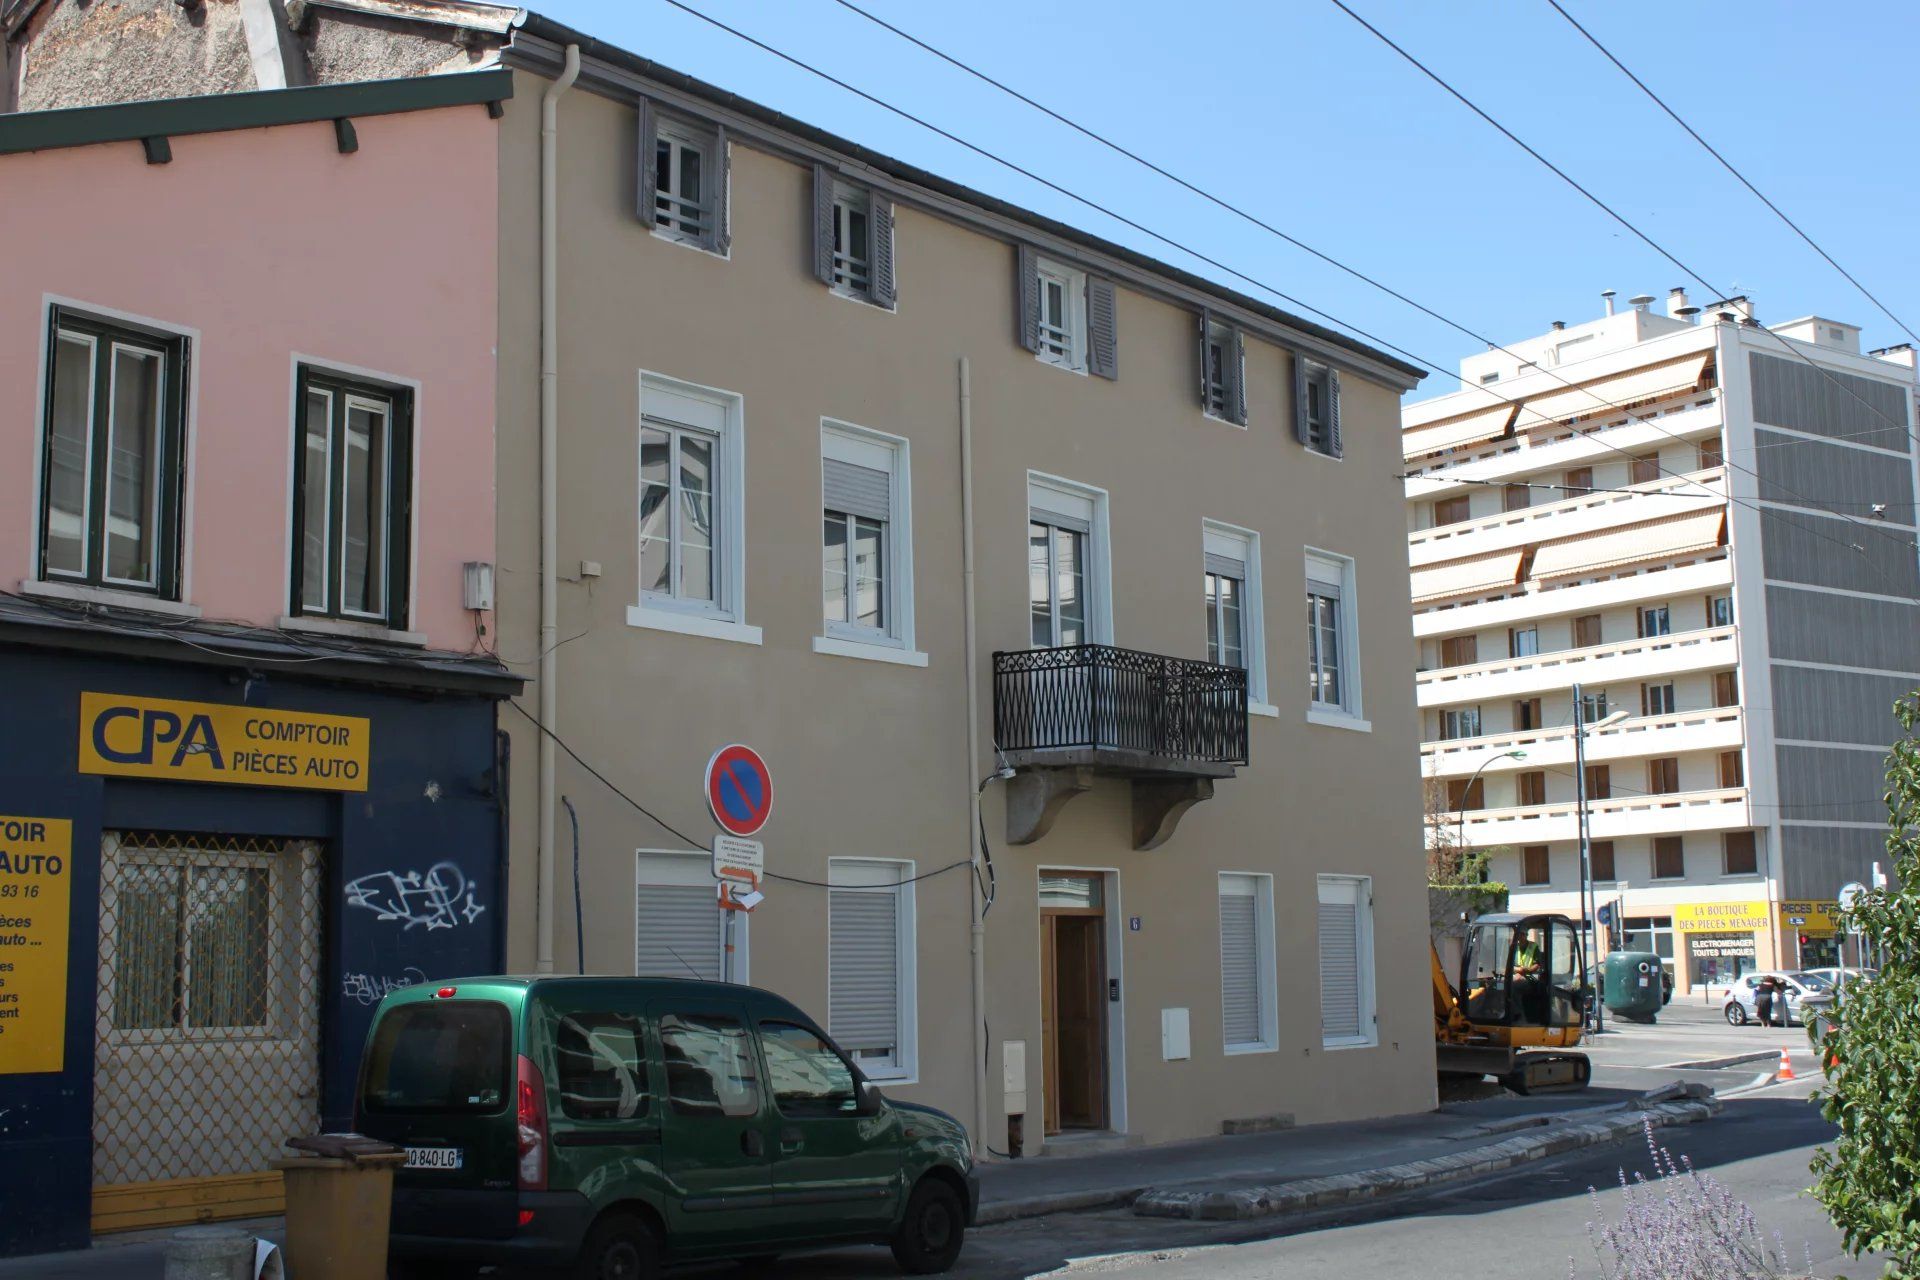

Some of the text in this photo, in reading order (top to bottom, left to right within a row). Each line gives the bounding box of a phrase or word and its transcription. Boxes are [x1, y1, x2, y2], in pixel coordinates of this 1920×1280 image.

[92, 706, 225, 769] CPA
[245, 719, 350, 746] COMPTOIR
[232, 748, 359, 780] PIÈCES AUTO
[0, 850, 62, 876] AUTO
[1, 884, 39, 898] 93 16
[1694, 904, 1749, 916] LA BOUTIQUE
[1781, 903, 1812, 914] PIECES
[1680, 918, 1768, 929] DES PIECES MENAGER
[1692, 939, 1754, 948] ELECTROMENAGER
[1693, 948, 1754, 957] TOUTES MARQUES
